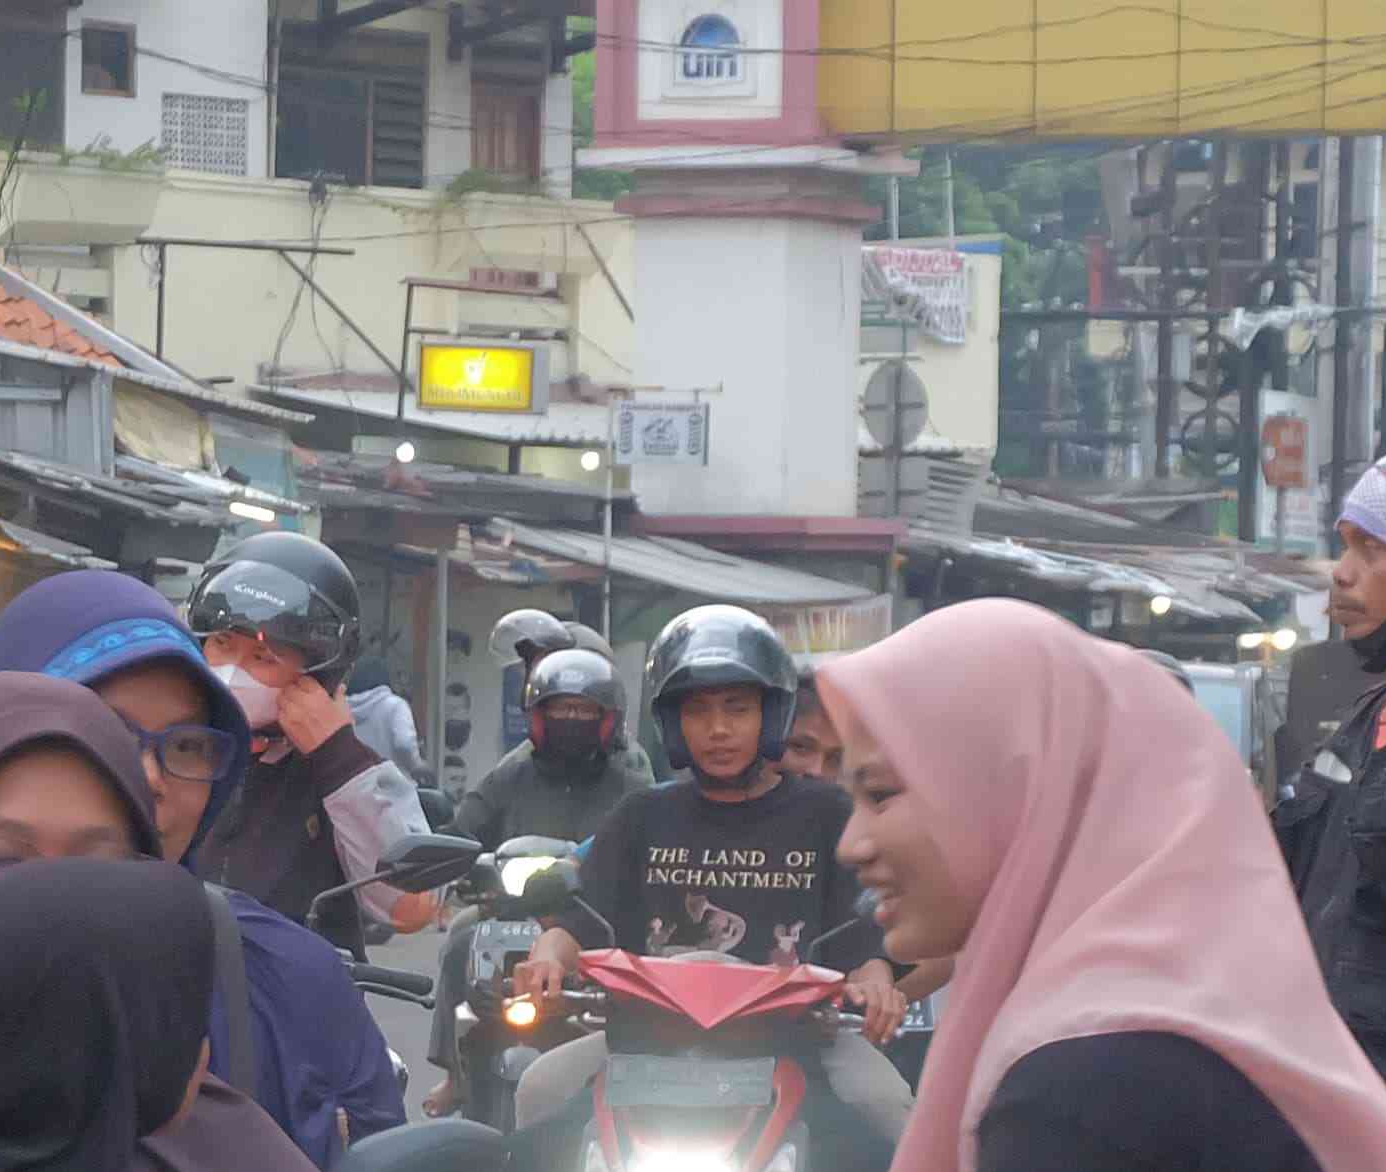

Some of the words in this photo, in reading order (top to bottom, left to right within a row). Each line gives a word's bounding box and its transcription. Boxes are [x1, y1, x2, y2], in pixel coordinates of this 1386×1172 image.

[648, 847, 690, 864] THE
[702, 848, 766, 866] LAND
[785, 851, 817, 868] OF
